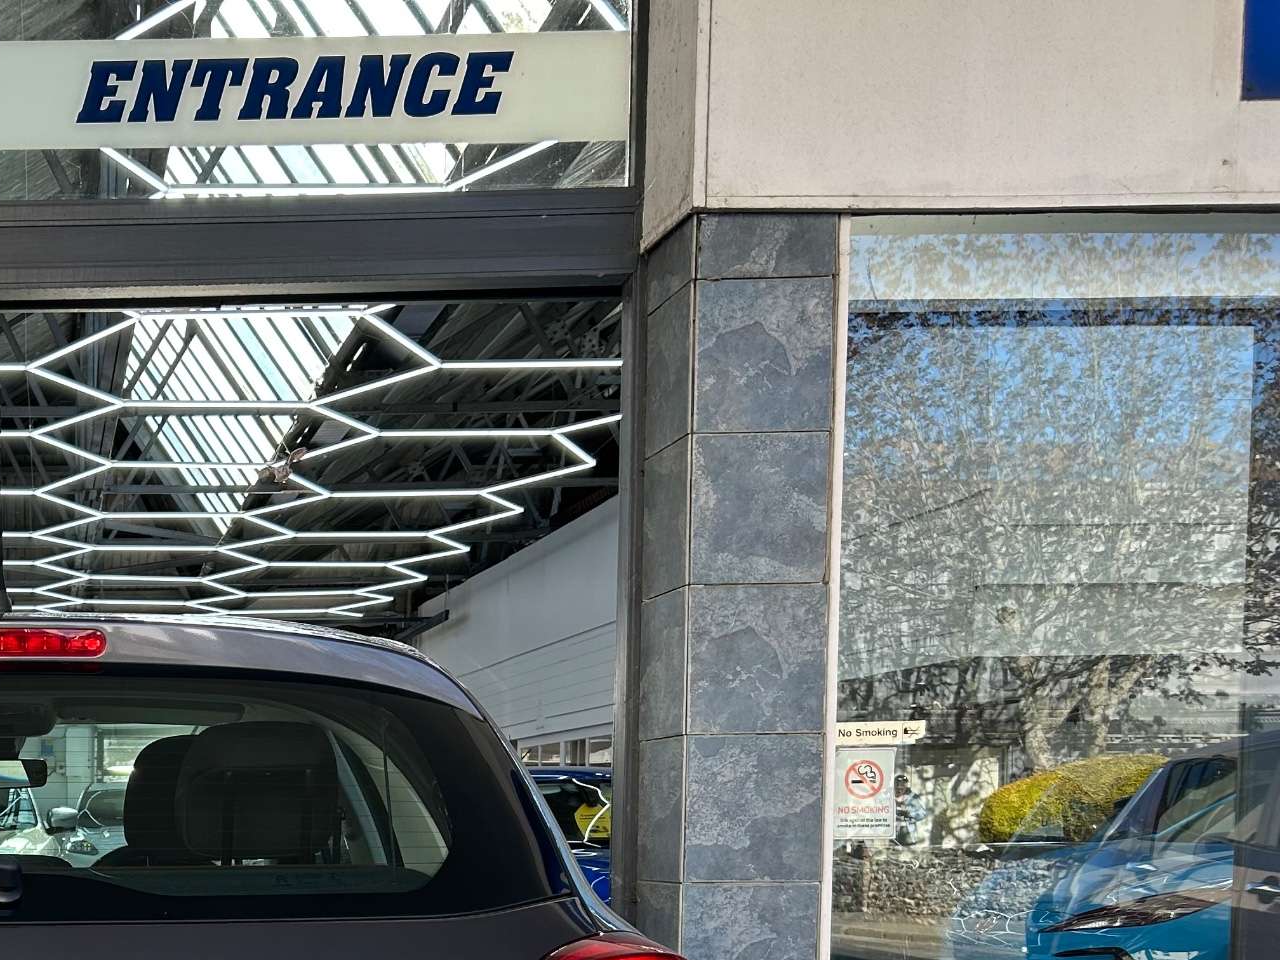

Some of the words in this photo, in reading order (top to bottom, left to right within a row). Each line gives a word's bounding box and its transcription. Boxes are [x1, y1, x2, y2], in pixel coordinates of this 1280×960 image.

[76, 51, 515, 125] ENTRANCE
[838, 728, 852, 738] No
[855, 726, 898, 738] Smoking
[837, 806, 850, 814] NO
